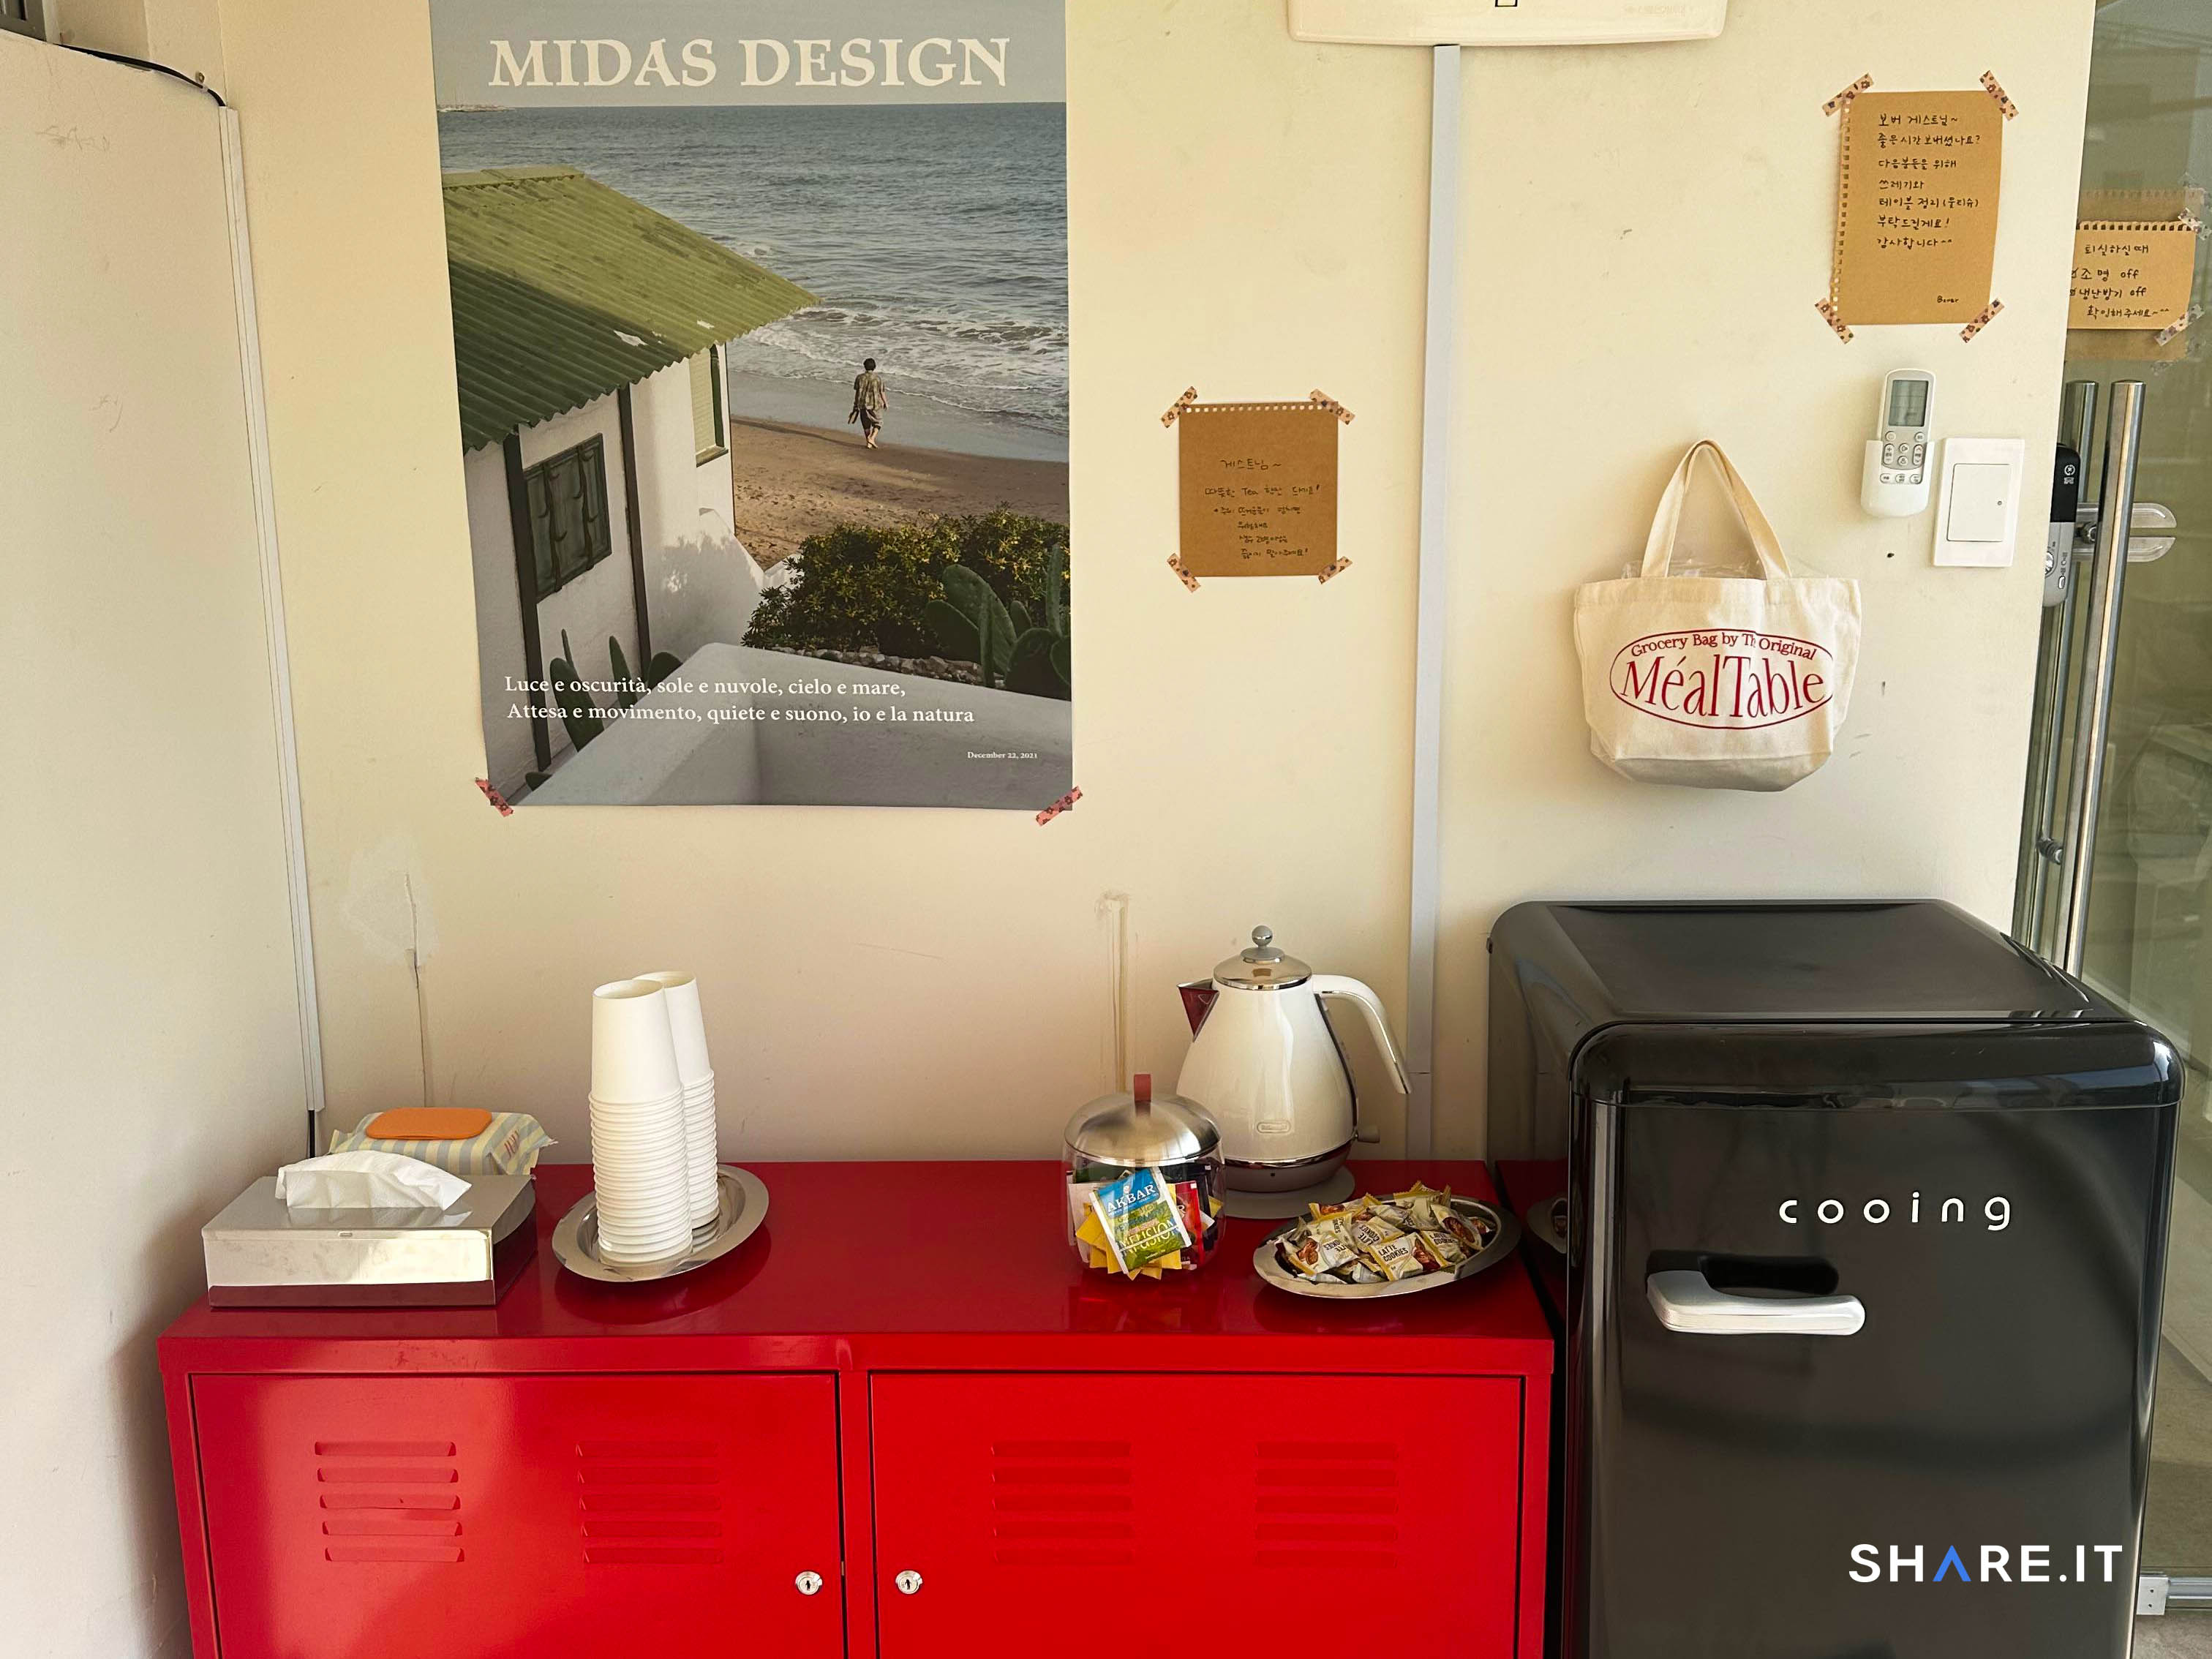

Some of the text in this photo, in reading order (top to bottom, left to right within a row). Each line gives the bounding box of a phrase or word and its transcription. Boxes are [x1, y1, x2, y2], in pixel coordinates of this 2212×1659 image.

[488, 37, 1010, 86] MIDAS DESIGN
[1878, 113, 1901, 127] 보버
[1877, 132, 1980, 149] 좋은 시간 보내셨나요?
[1933, 159, 1957, 170] 위해
[1878, 179, 1925, 190] 쓰레기와
[1878, 195, 1914, 211] 테이블
[2120, 268, 2140, 280] off
[2078, 285, 2148, 301] 냉난방기 off
[1241, 486, 1260, 496] Tea
[1631, 635, 1688, 658] Grocery
[1692, 633, 1718, 648] Bag
[1722, 632, 1739, 647] by
[1758, 638, 1818, 661] Original
[505, 676, 906, 697] Luce e oscurità, sole e nuvole, cielo e mare,
[507, 704, 975, 724] Attesa e movimento, quiete e suono, io e la natura
[1007, 752, 1019, 760] 22,
[1107, 1184, 1156, 1213] AKBAR
[1778, 1191, 2011, 1231] cooing
[1378, 1244, 1398, 1257] LATTE
[1382, 1247, 1409, 1263] COOKIES
